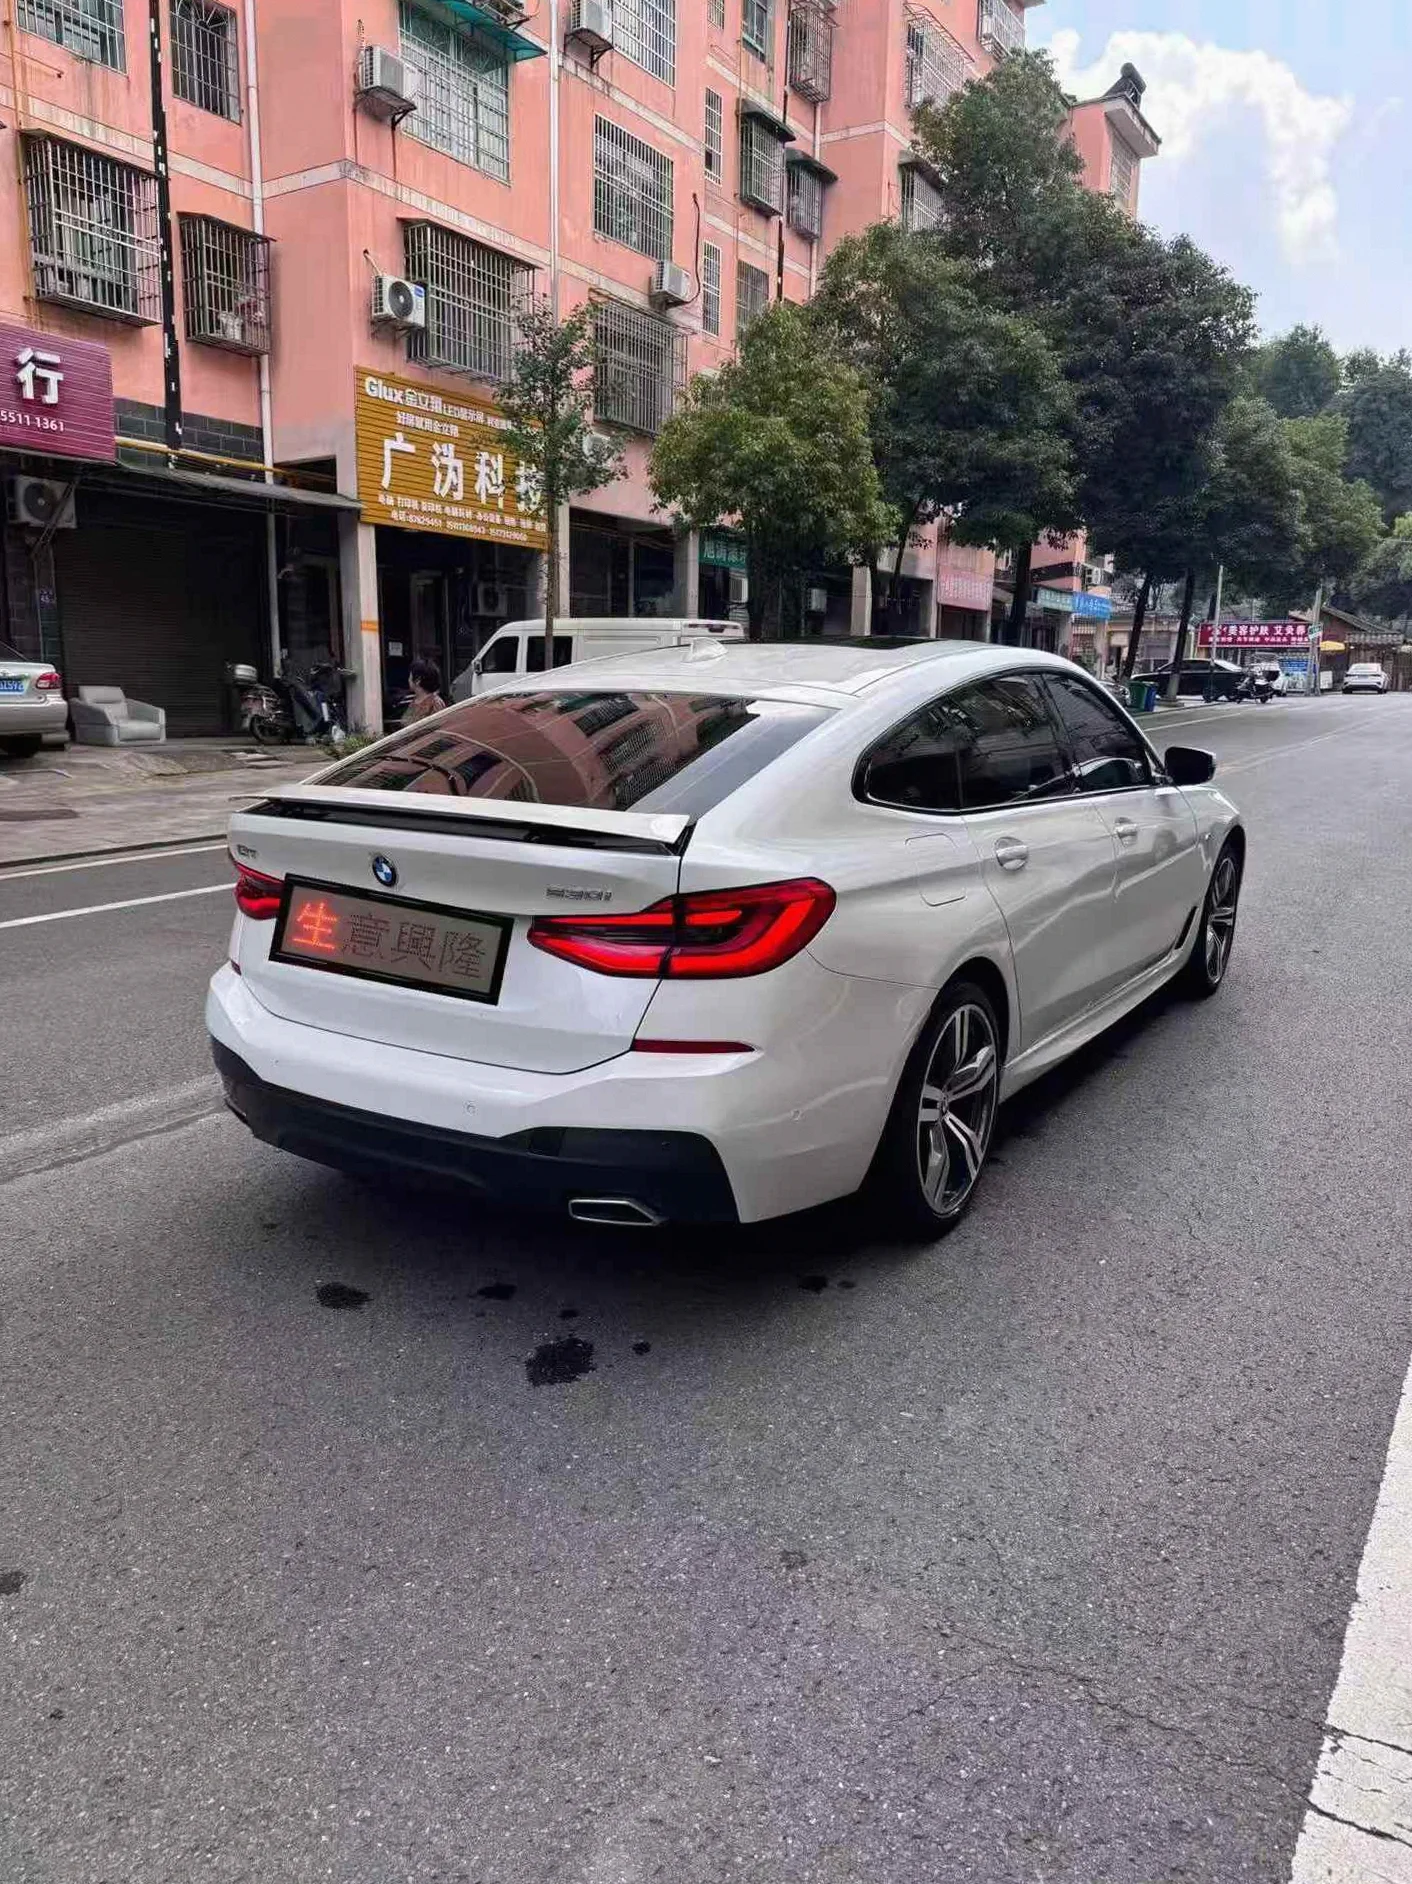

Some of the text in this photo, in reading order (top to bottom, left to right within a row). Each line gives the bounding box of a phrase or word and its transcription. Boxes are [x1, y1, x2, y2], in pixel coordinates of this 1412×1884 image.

[17, 347, 64, 404] 行
[0, 410, 64, 432] 5511 1361
[293, 902, 485, 979] 生意興隆
